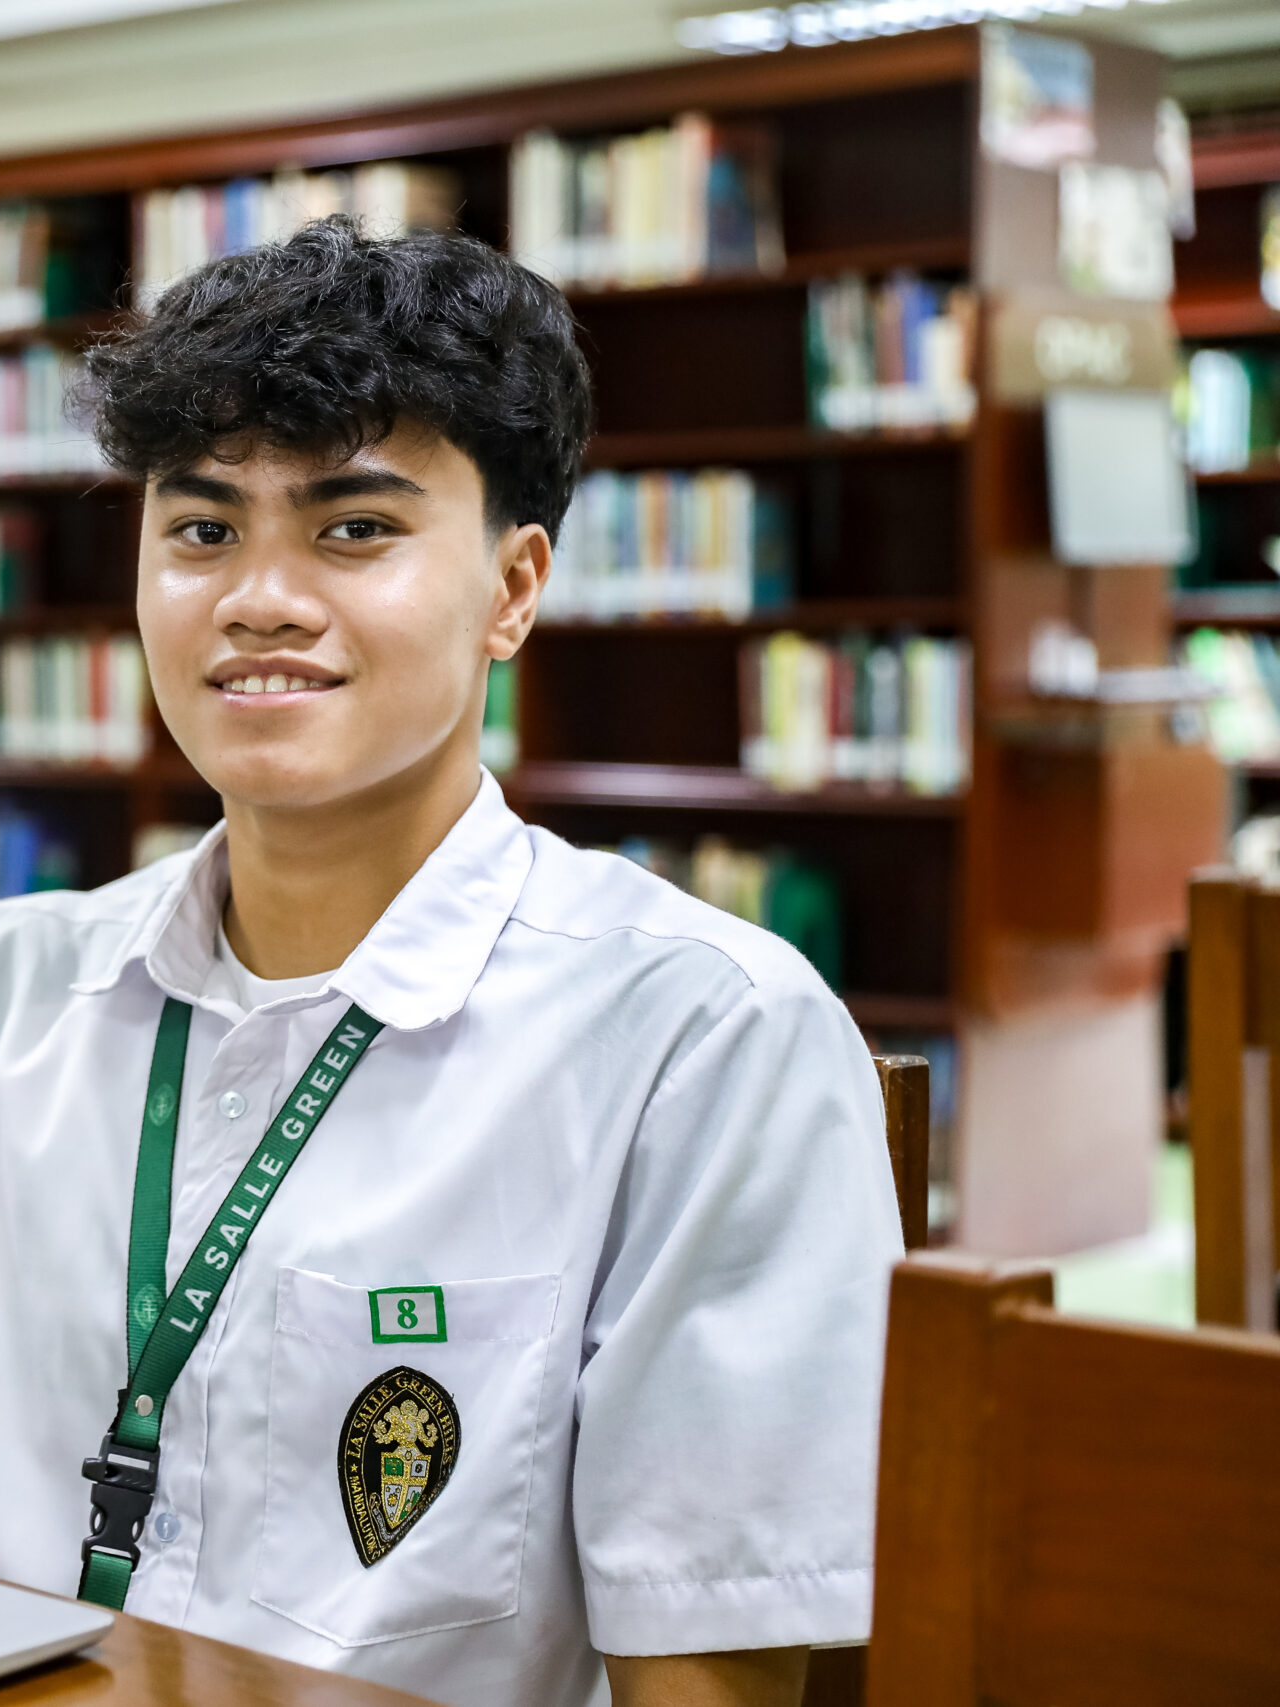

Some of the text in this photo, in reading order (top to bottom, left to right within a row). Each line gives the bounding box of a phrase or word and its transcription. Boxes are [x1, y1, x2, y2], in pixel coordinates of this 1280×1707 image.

[169, 1023, 367, 1334] LA SALLE GREEN
[396, 1298, 418, 1330] 8
[353, 1385, 393, 1432] SALLE
[347, 1436, 363, 1458] LA
